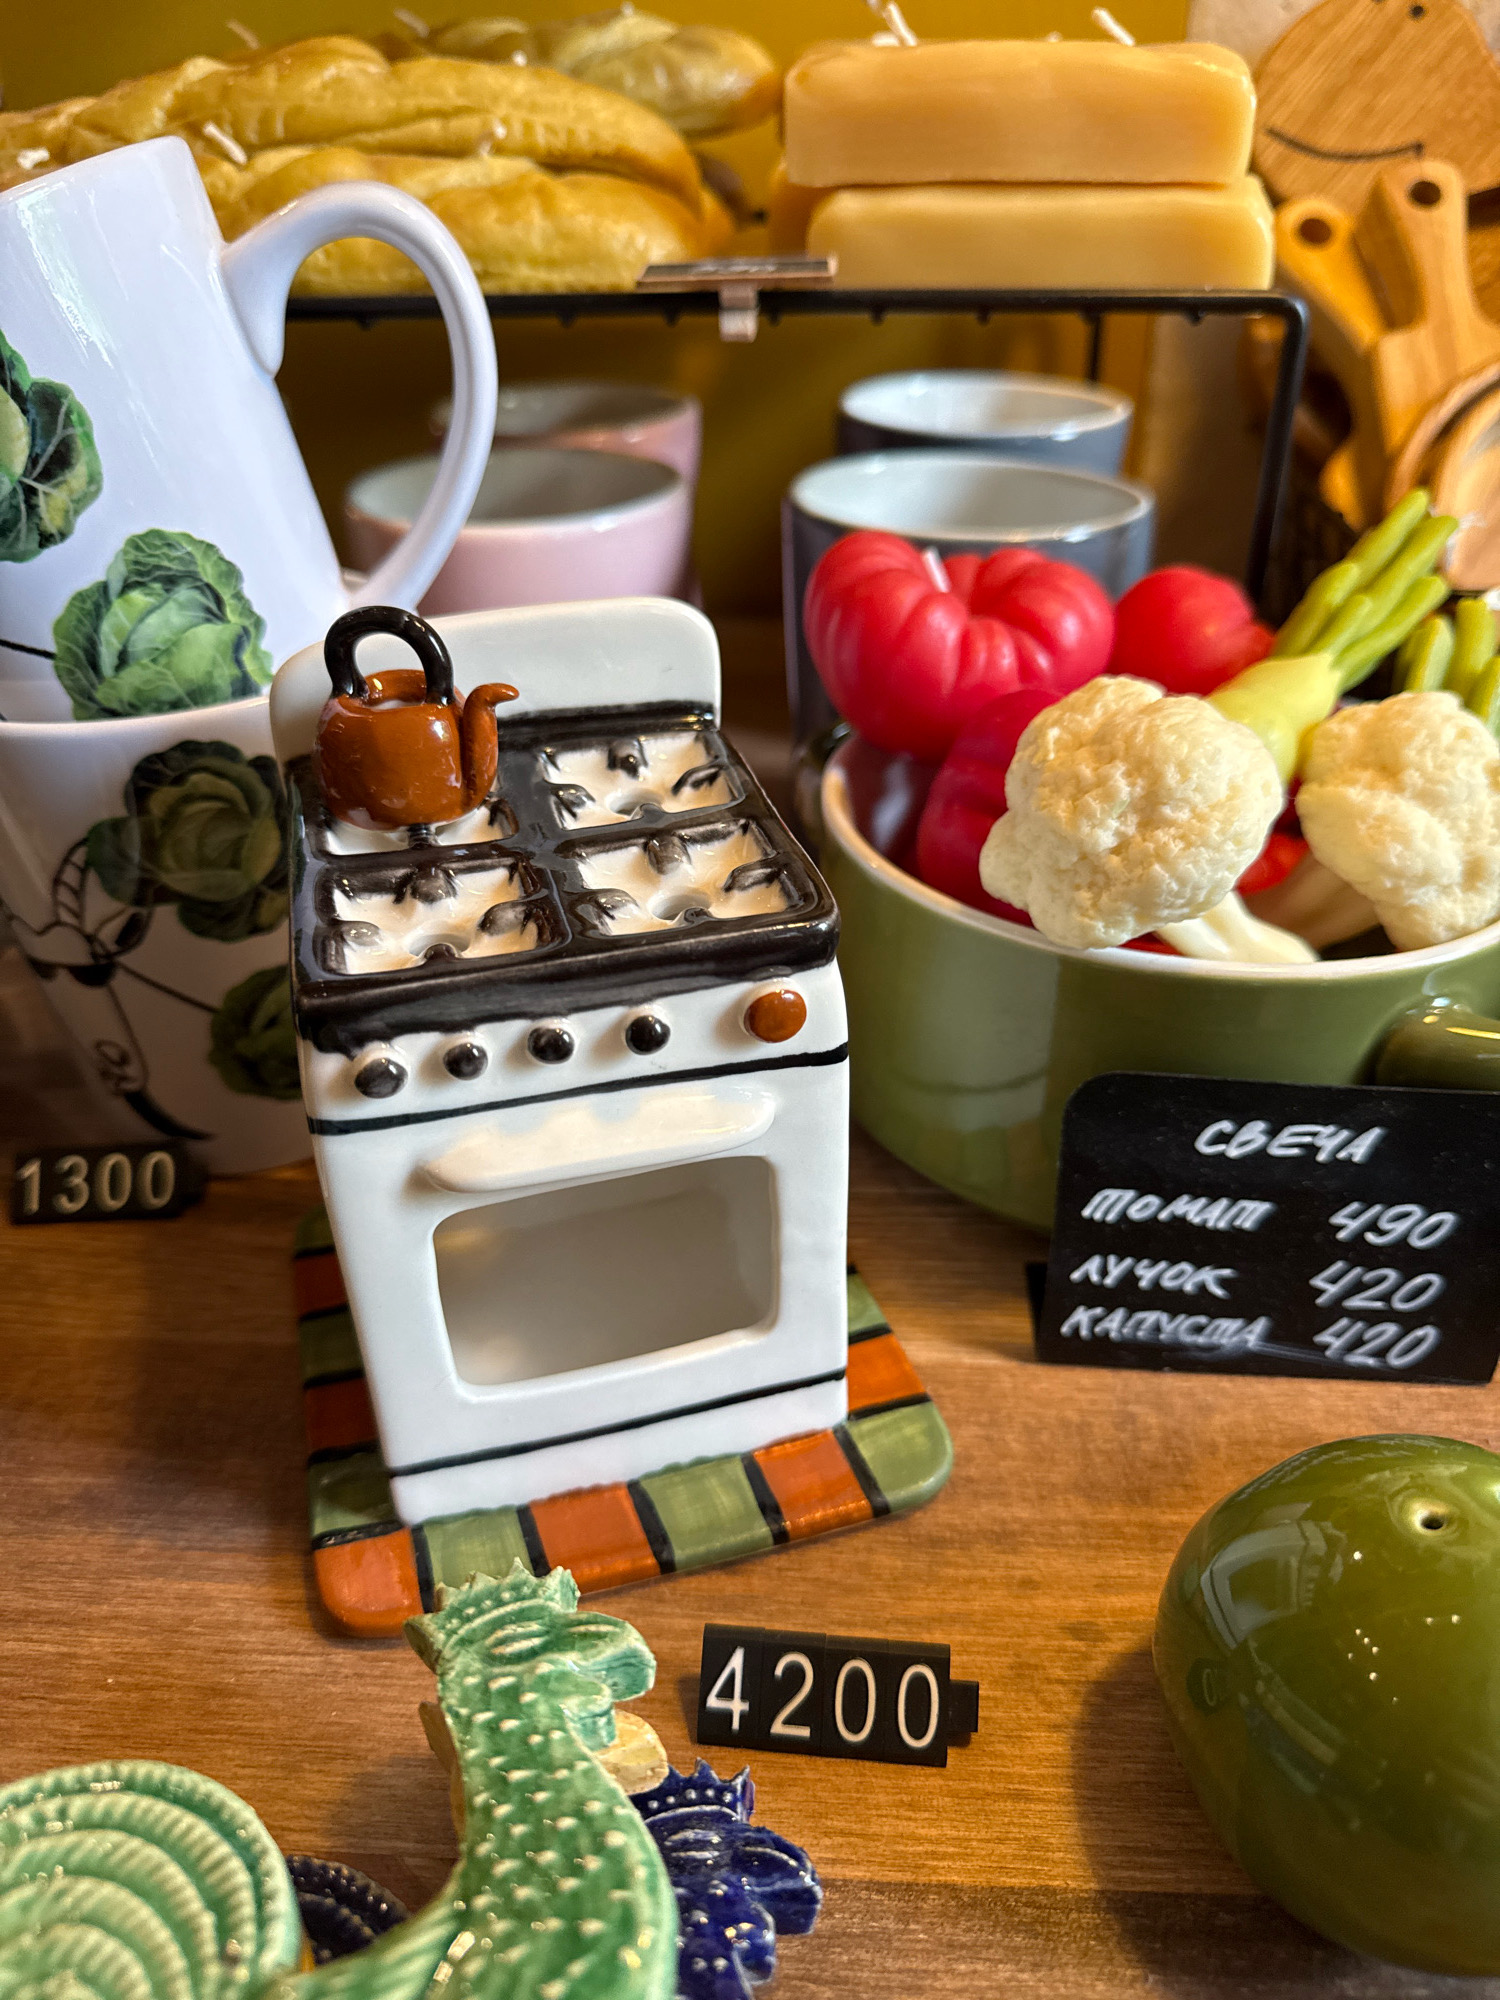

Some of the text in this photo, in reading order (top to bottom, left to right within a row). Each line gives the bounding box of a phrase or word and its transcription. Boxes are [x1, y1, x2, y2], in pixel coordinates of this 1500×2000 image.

[1195, 1119, 1386, 1164] СВЕЧА
[15, 1150, 176, 1216] 1300
[1328, 1201, 1460, 1250] 490
[1069, 1254, 1447, 1312] ЛУЧОК 420
[1060, 1305, 1442, 1370] КАПУСТА 420
[706, 1645, 940, 1749] 4200
